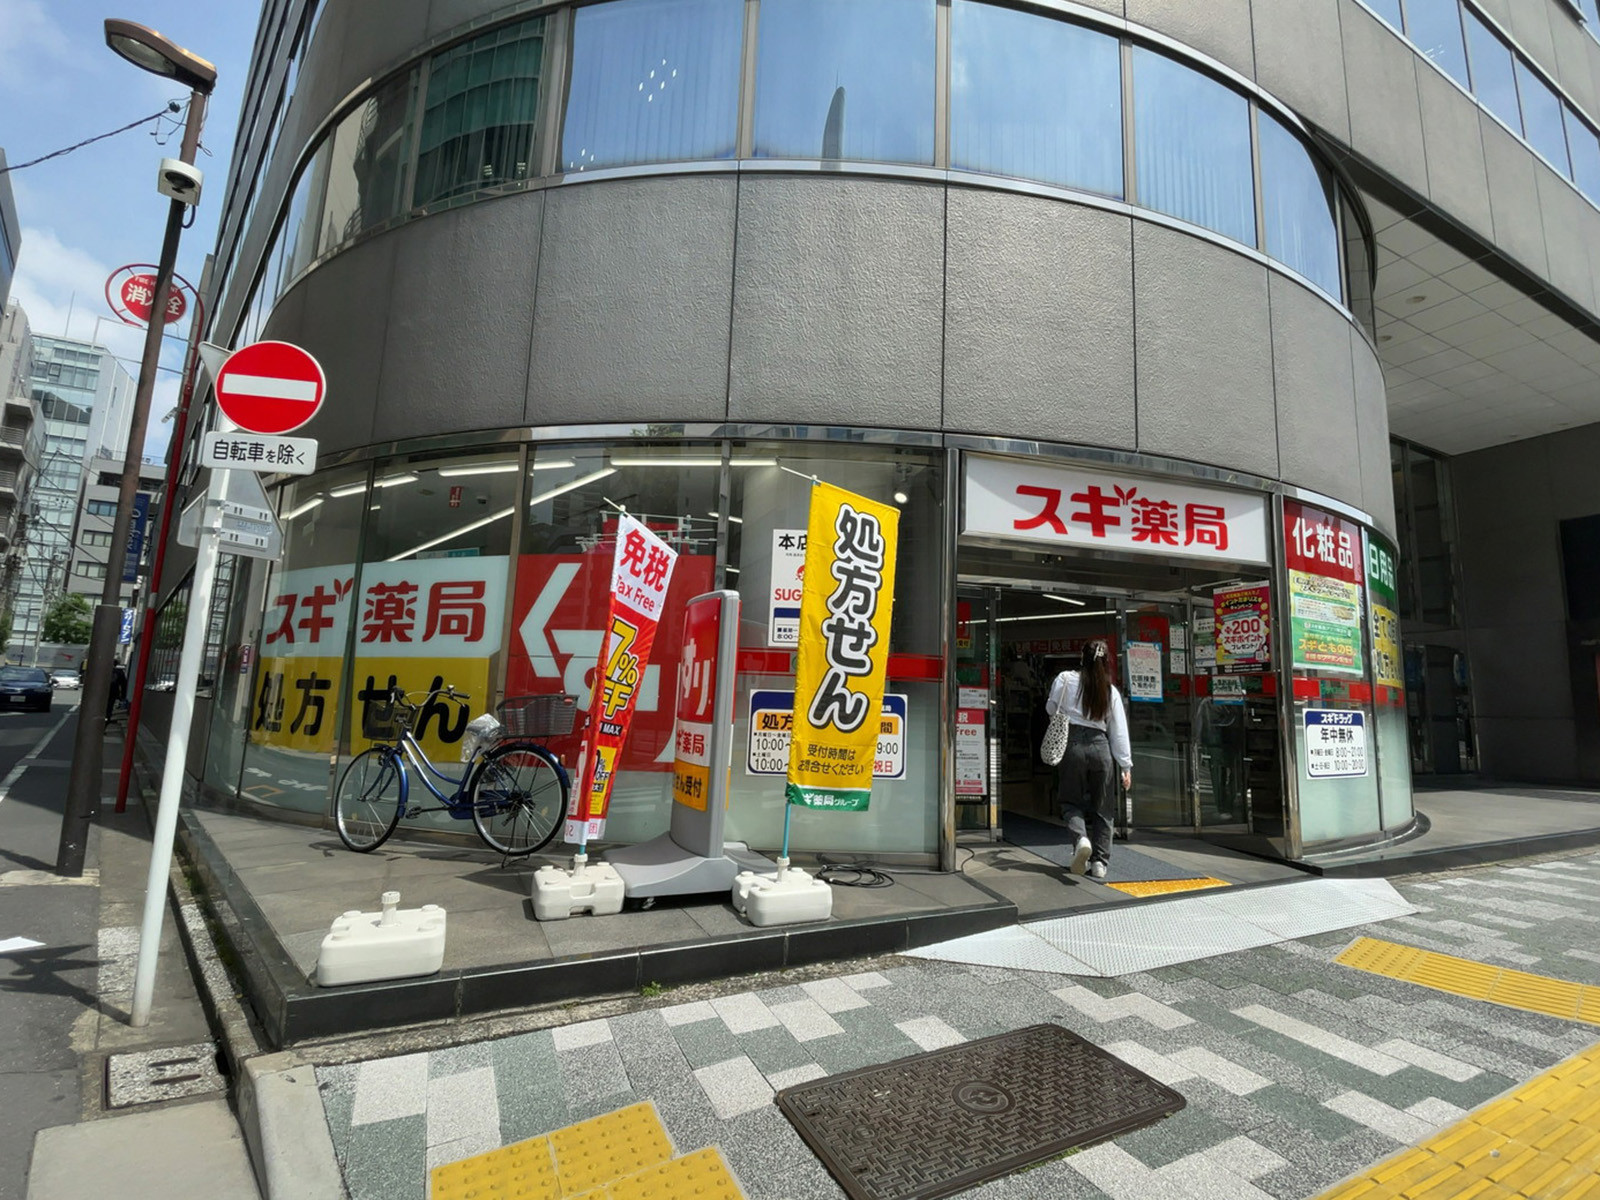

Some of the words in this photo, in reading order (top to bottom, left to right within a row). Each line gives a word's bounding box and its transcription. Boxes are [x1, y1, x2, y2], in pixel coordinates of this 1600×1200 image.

[213, 439, 305, 465] 自転車を除く
[1013, 484, 1229, 551] スギ薬局
[1292, 517, 1354, 569] 化粧品
[620, 528, 670, 593] 免税
[266, 577, 486, 645] スギ薬局
[635, 587, 656, 612] Free
[809, 505, 885, 732] 処方せん
[603, 723, 621, 735] MAX
[1320, 713, 1353, 724] スギドラッグ
[1320, 727, 1354, 743] 年中無休
[807, 744, 857, 760] 受付時間は
